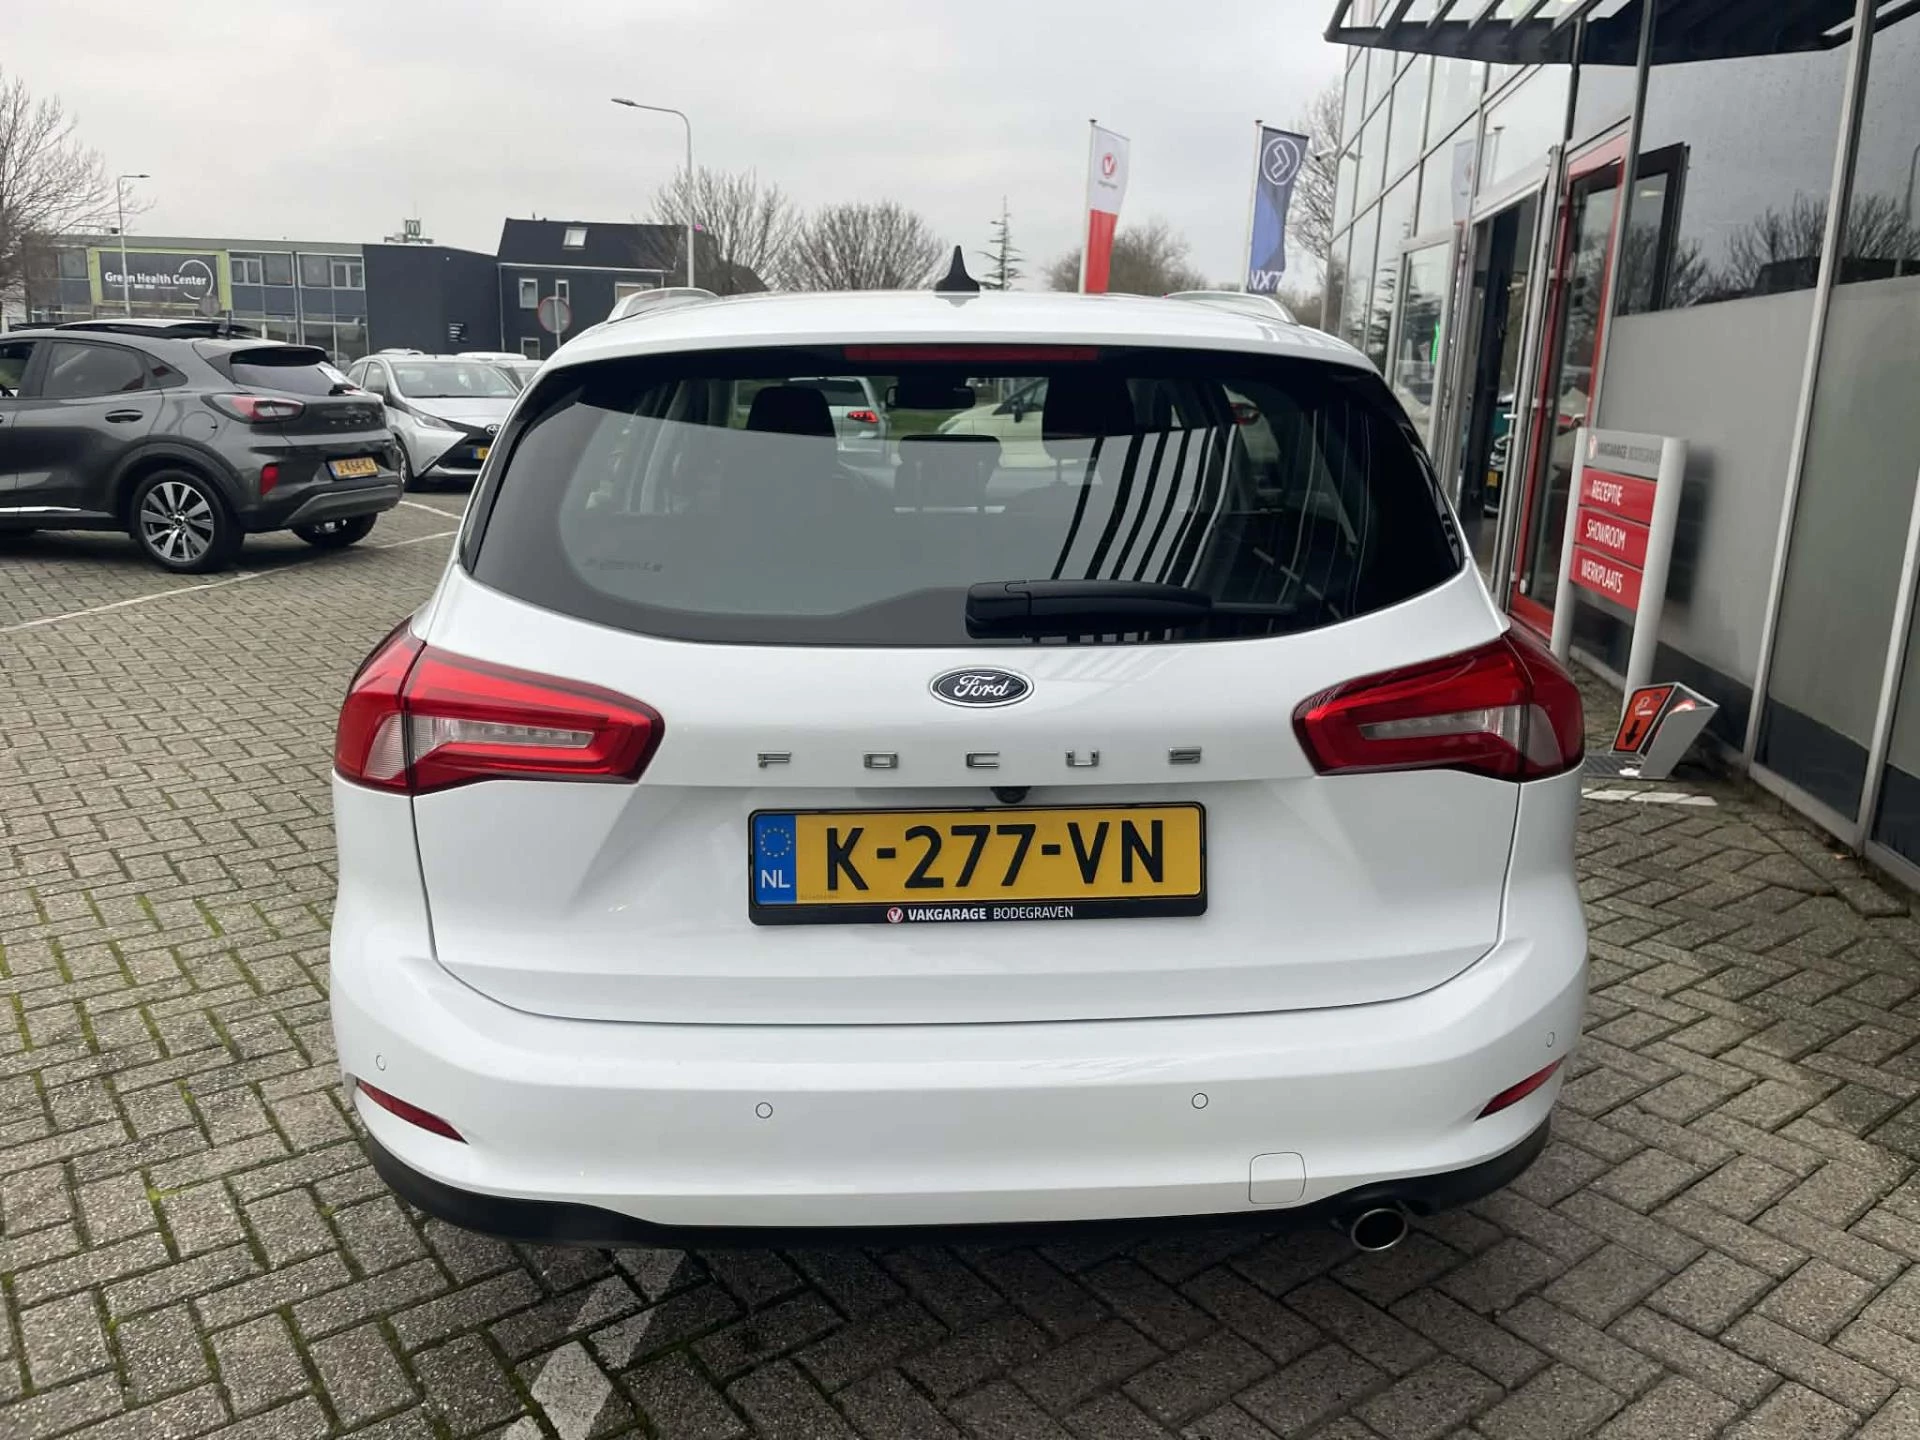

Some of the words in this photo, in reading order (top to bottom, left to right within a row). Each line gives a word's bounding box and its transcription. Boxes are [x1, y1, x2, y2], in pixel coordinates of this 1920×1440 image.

[137, 273, 171, 285] Health
[172, 275, 206, 286] Center
[1591, 480, 1623, 506] RECEPTIE
[1586, 519, 1626, 550] SHOWROOM
[1581, 558, 1624, 594] WERKPLAATS
[954, 675, 1010, 697] Ford
[758, 747, 1201, 768] FOCUS
[826, 820, 1164, 890] K-277-VN
[761, 869, 790, 888] NL
[908, 908, 987, 921] VAKGARAGE
[993, 906, 1074, 919] BODEGRAVEN
